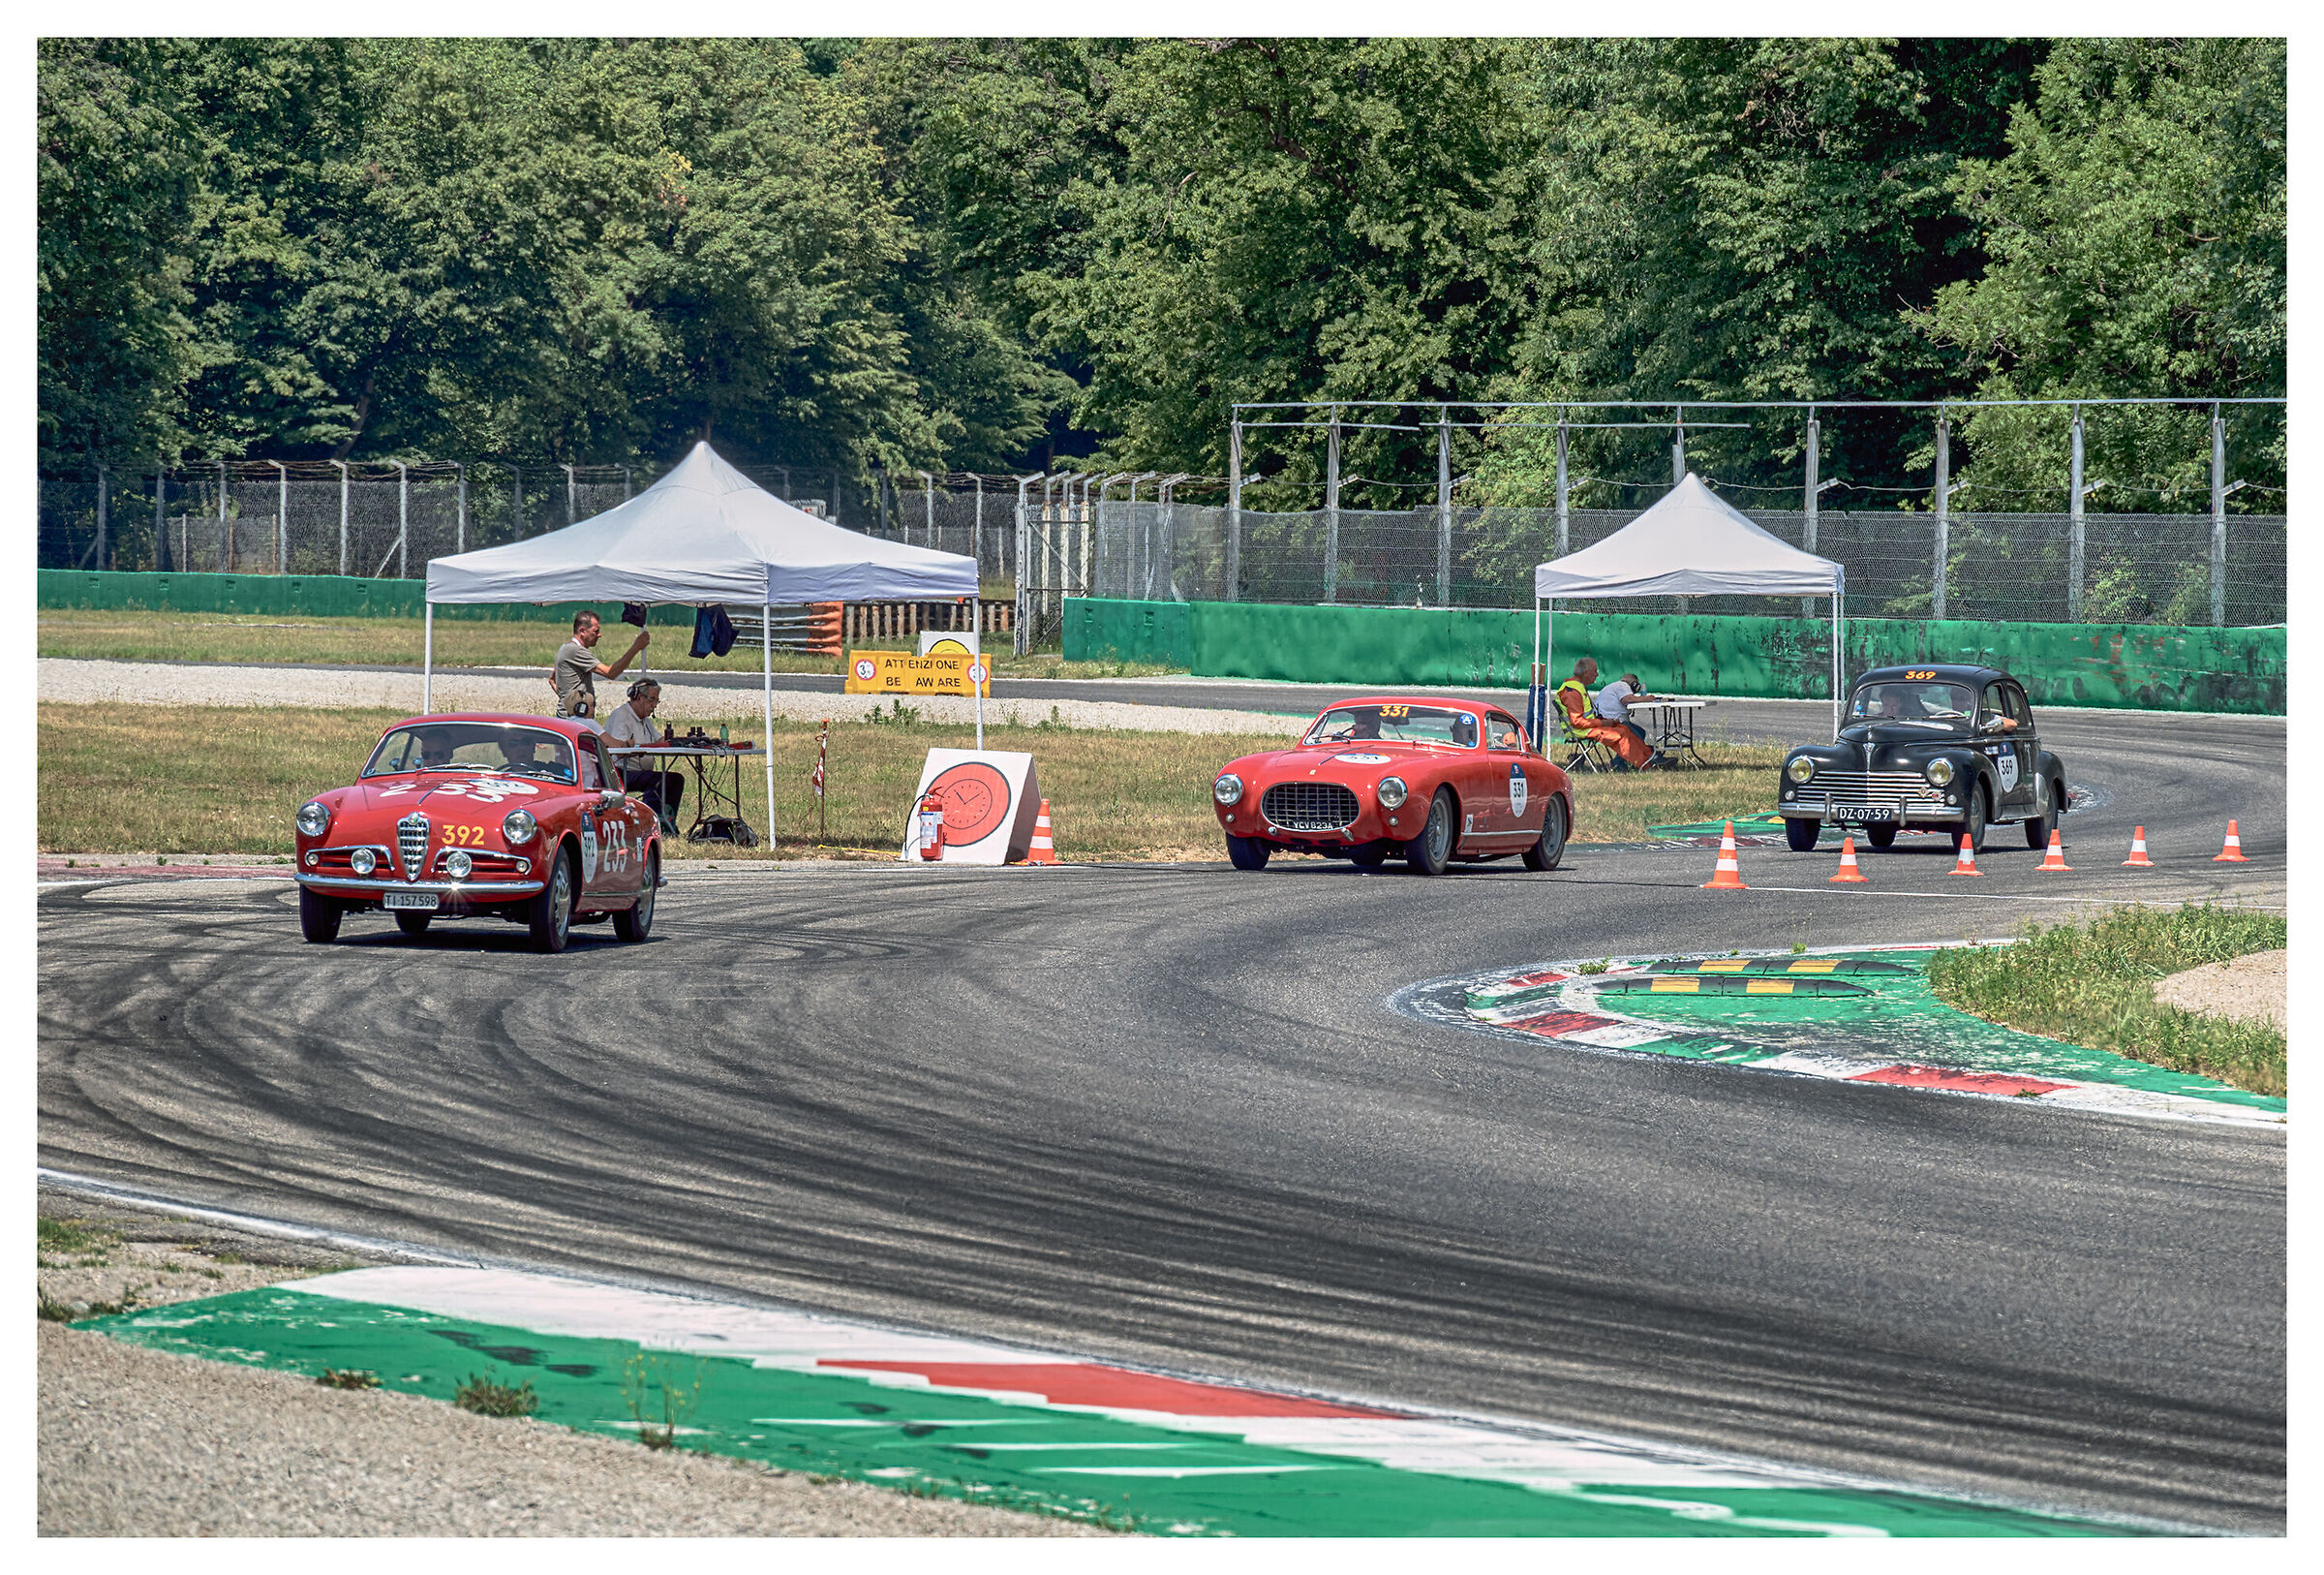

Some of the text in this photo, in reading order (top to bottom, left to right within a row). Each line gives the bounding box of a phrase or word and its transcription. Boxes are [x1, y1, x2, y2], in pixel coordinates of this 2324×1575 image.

[886, 677, 902, 686] BE
[1905, 670, 1937, 680] 369
[1379, 705, 1410, 717] 331
[2002, 759, 2013, 775] 369
[1513, 782, 1524, 798] 331
[1840, 808, 1889, 819] DZ-07-59
[442, 824, 485, 846] 392
[583, 836, 595, 857] 392
[602, 820, 627, 873] 233
